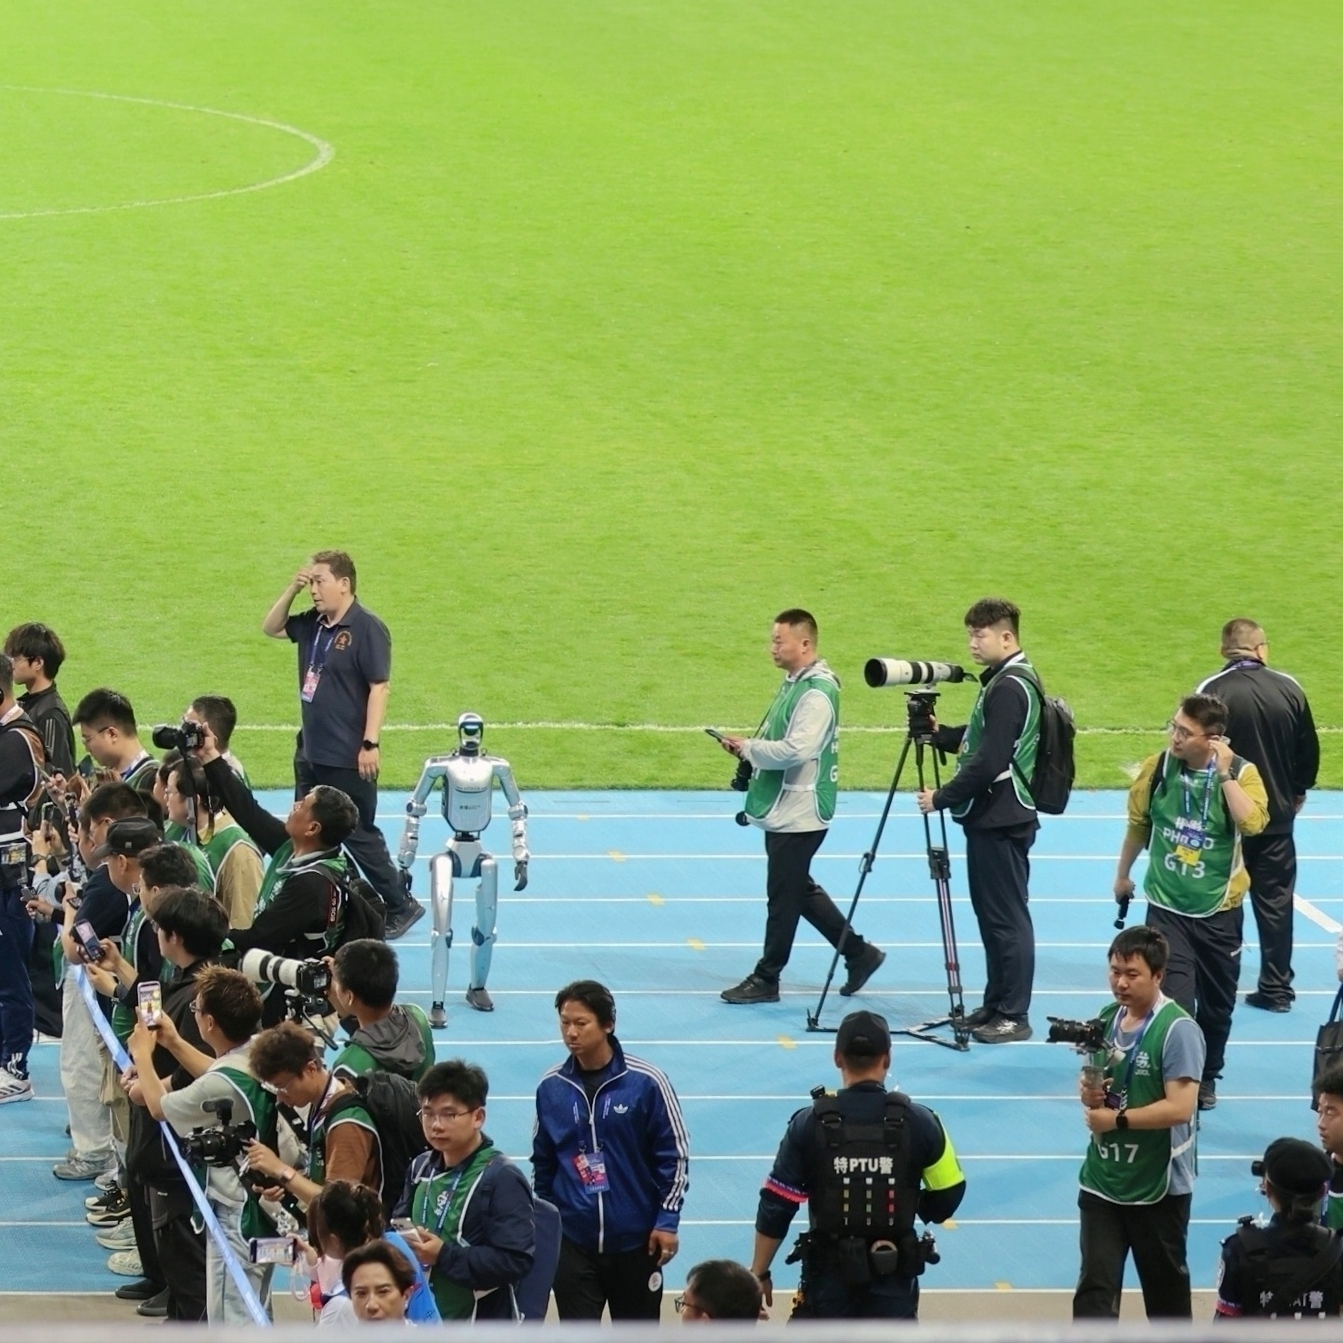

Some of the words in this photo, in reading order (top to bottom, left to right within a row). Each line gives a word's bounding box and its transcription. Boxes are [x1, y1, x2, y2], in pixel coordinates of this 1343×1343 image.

[1162, 826, 1214, 851] PHOO
[1097, 1142, 1140, 1164] G17
[833, 1156, 894, 1175] 特PTU警
